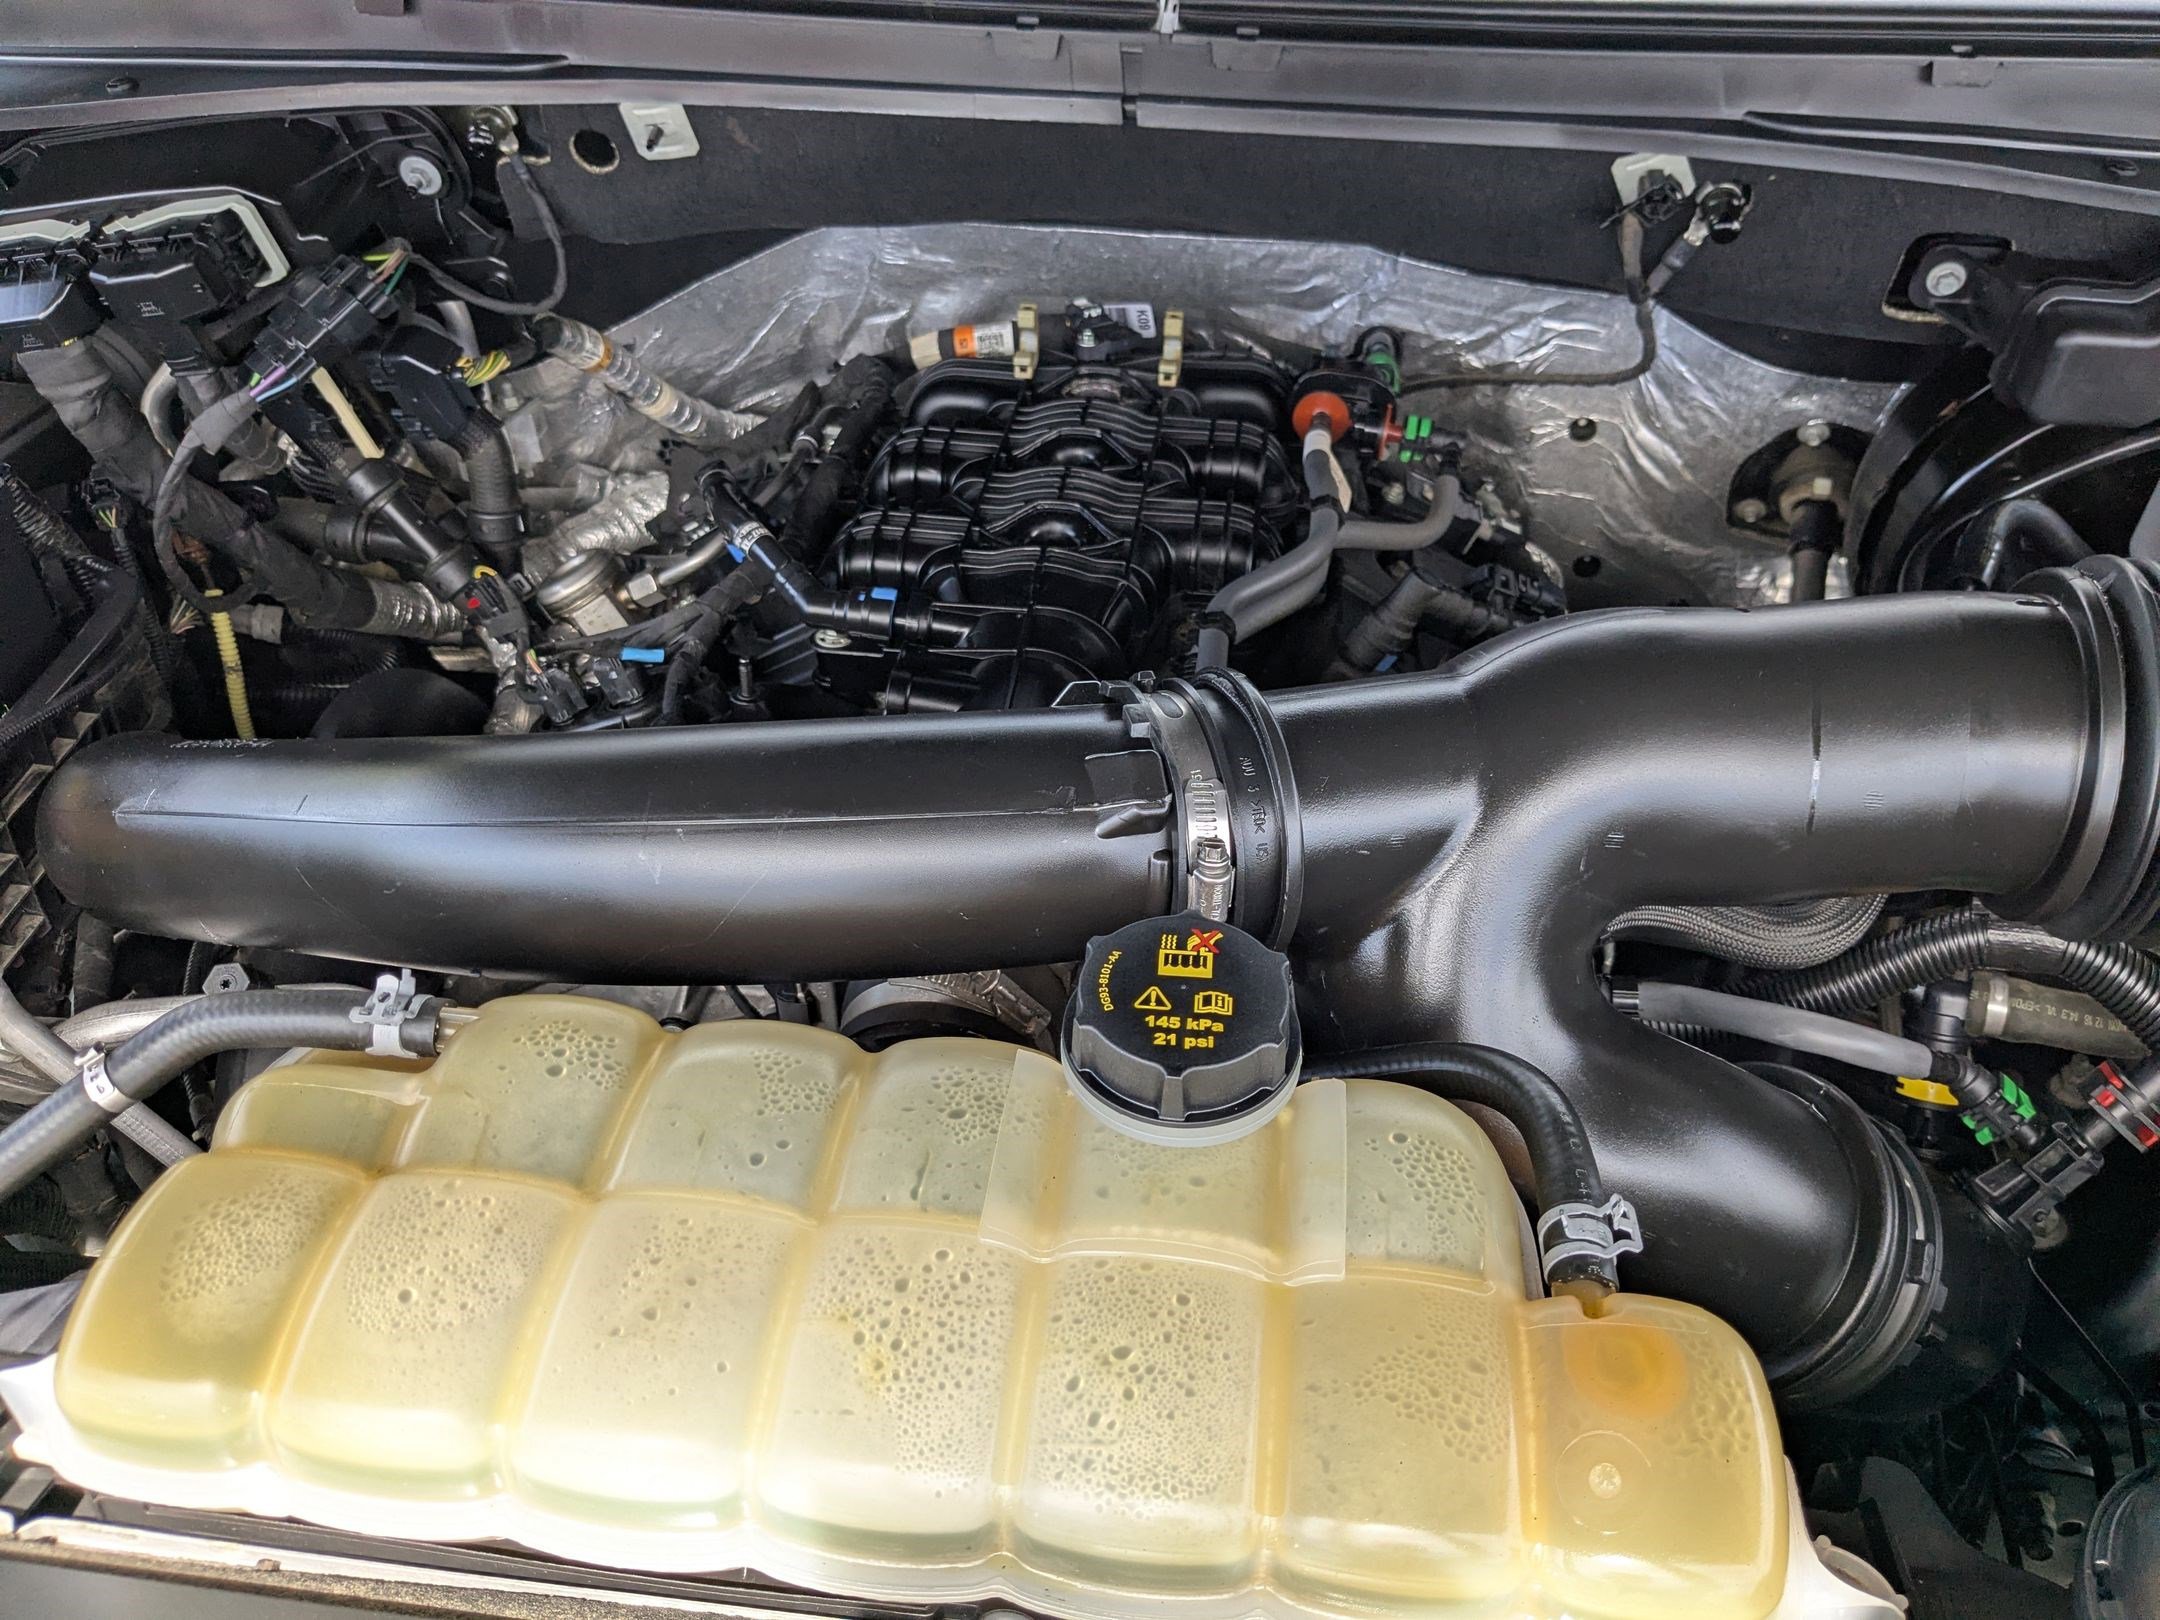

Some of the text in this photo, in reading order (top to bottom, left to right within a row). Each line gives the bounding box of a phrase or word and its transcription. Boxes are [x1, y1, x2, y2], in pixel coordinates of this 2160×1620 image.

[1136, 310, 1151, 331] K09
[1099, 951, 1122, 1011] DG93-8101-AA
[1145, 1015, 1224, 1032] 145 kPa
[1153, 1032, 1214, 1050] 21 psi
